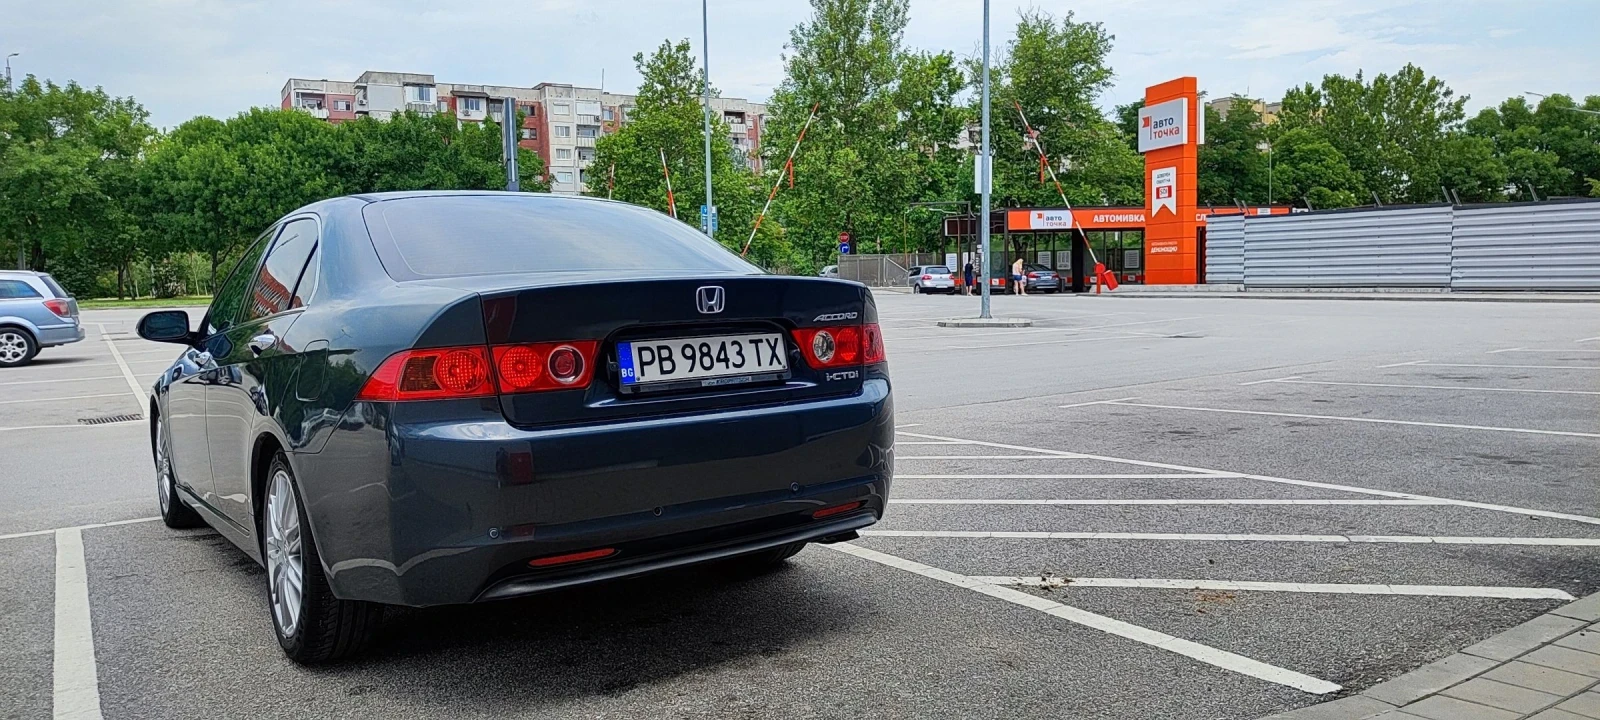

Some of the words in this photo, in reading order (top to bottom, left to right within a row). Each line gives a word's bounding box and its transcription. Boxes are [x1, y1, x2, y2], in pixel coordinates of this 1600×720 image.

[1153, 117, 1174, 129] авто
[1153, 126, 1180, 140] точка
[1093, 214, 1146, 223] АВТОМИВКА
[813, 312, 858, 321] ACCORD
[637, 345, 677, 377] PB
[681, 340, 746, 373] 9843
[748, 337, 783, 367] TX
[621, 368, 634, 378] BG
